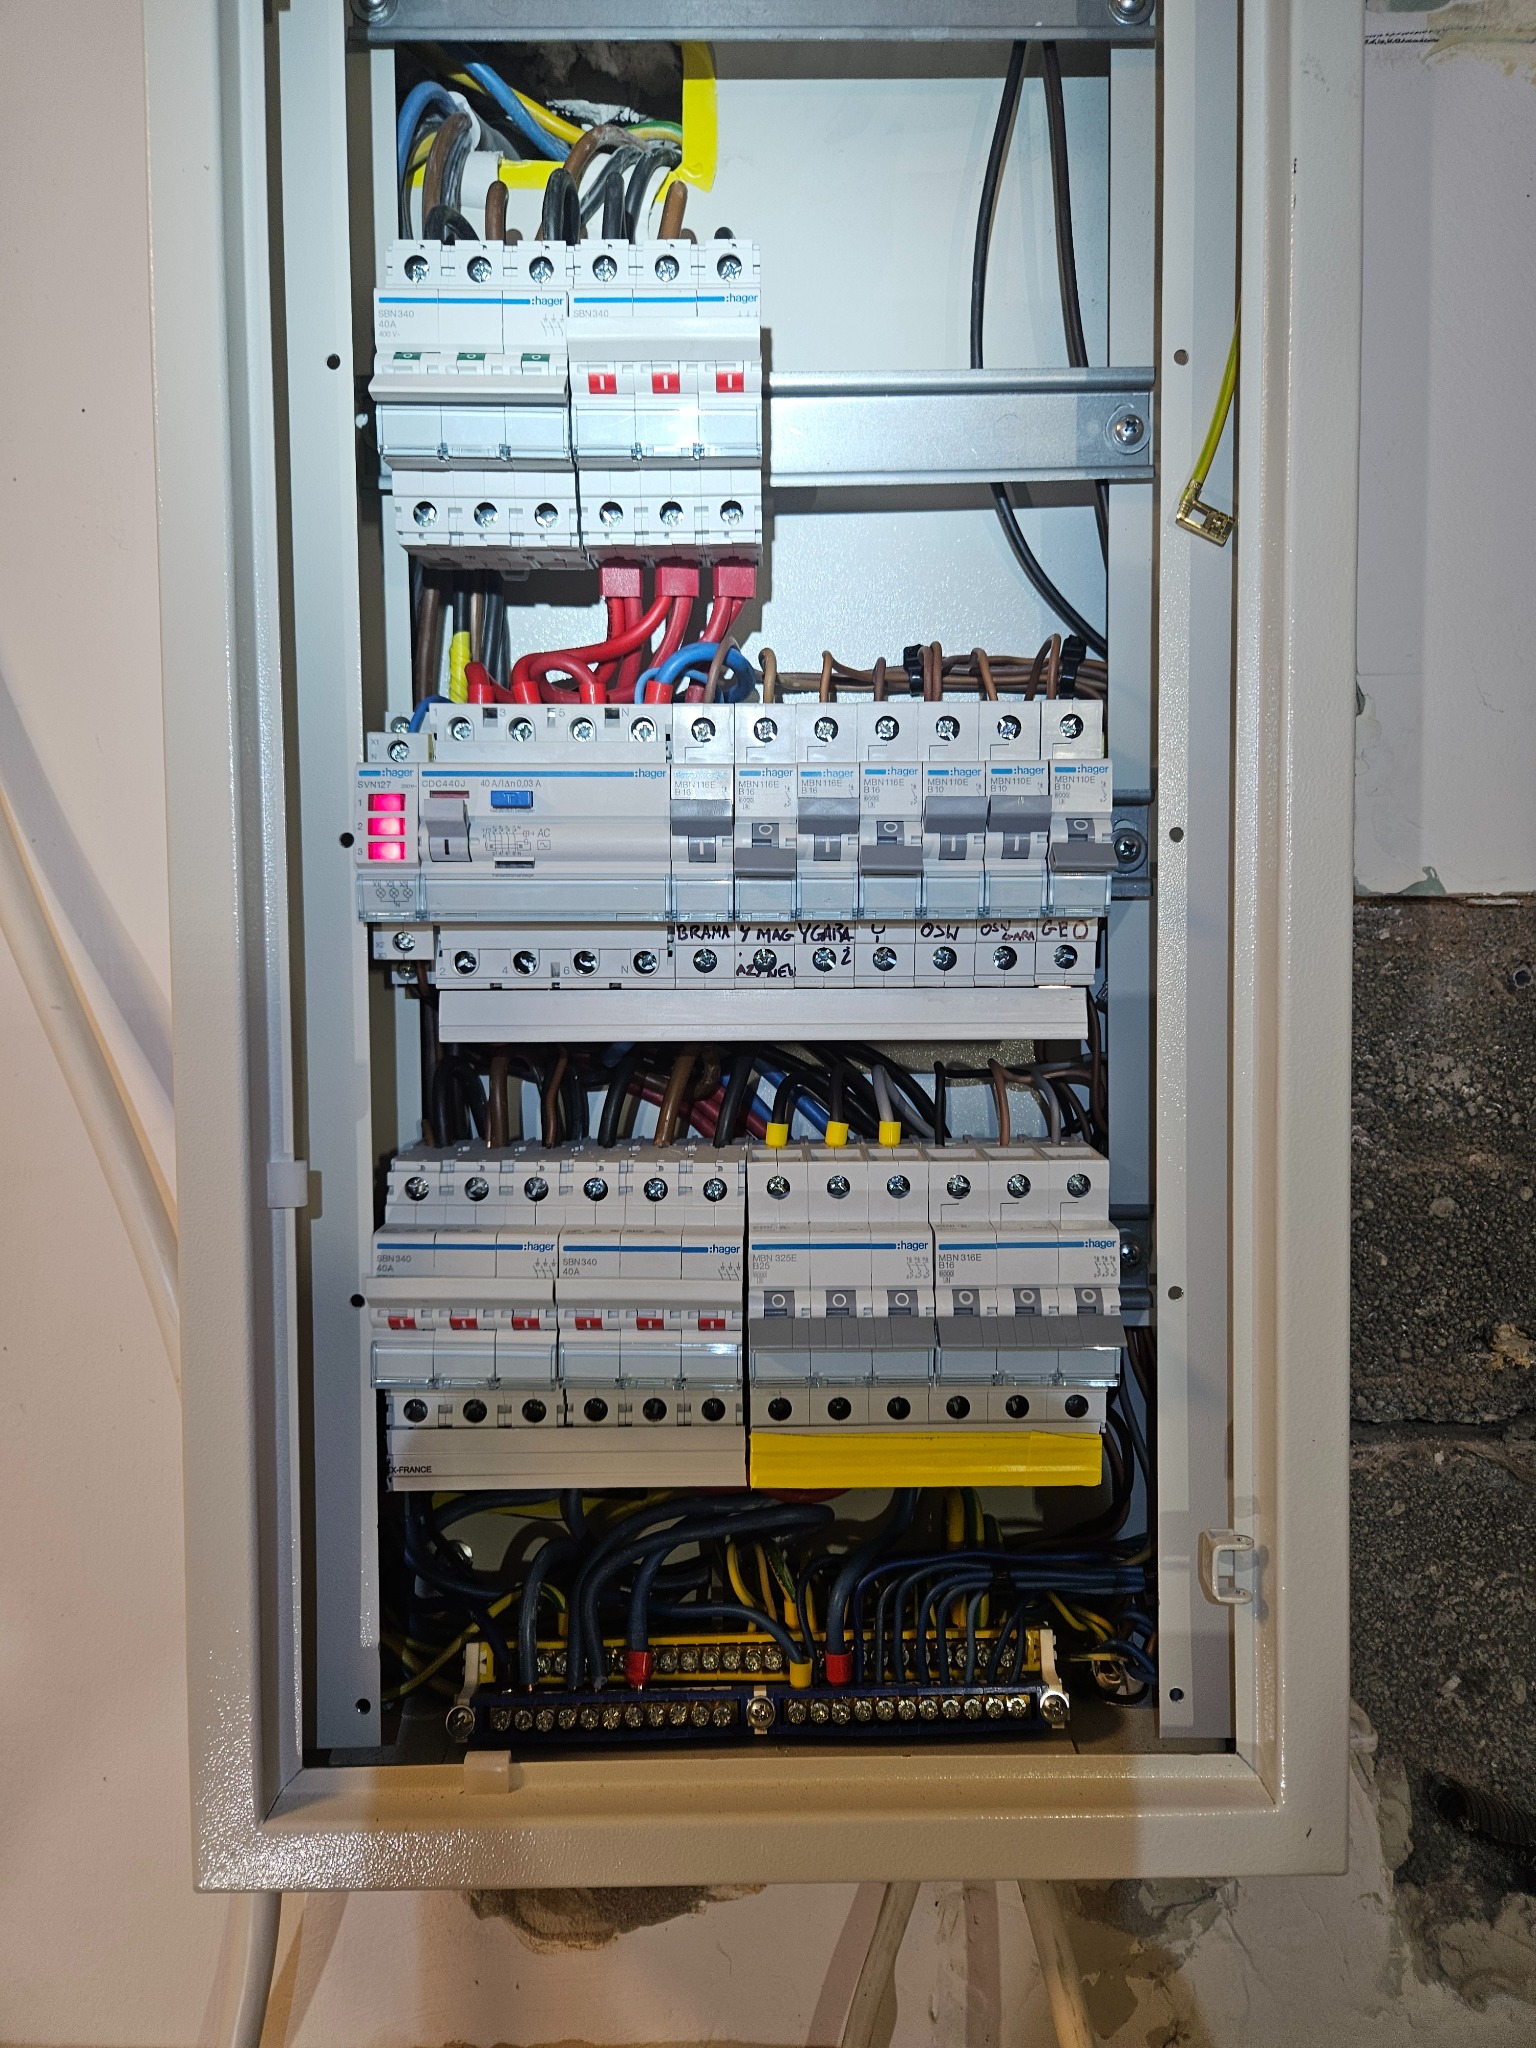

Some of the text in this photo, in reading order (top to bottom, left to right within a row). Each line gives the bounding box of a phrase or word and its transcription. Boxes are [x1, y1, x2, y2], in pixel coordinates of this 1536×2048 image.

[379, 320, 397, 328] 40A
[499, 708, 506, 717] 3
[558, 708, 566, 717] 5
[621, 708, 630, 717] N
[357, 781, 392, 789] SVN127
[537, 828, 551, 838] AC
[756, 928, 795, 943] MAG
[439, 967, 446, 976] 2
[502, 967, 509, 975] 4
[563, 966, 570, 975] 6
[620, 966, 629, 975] N
[376, 1255, 411, 1263] SBN340
[562, 1258, 598, 1266] SBN340
[376, 1264, 394, 1272] 40A
[562, 1268, 580, 1276] 40A
